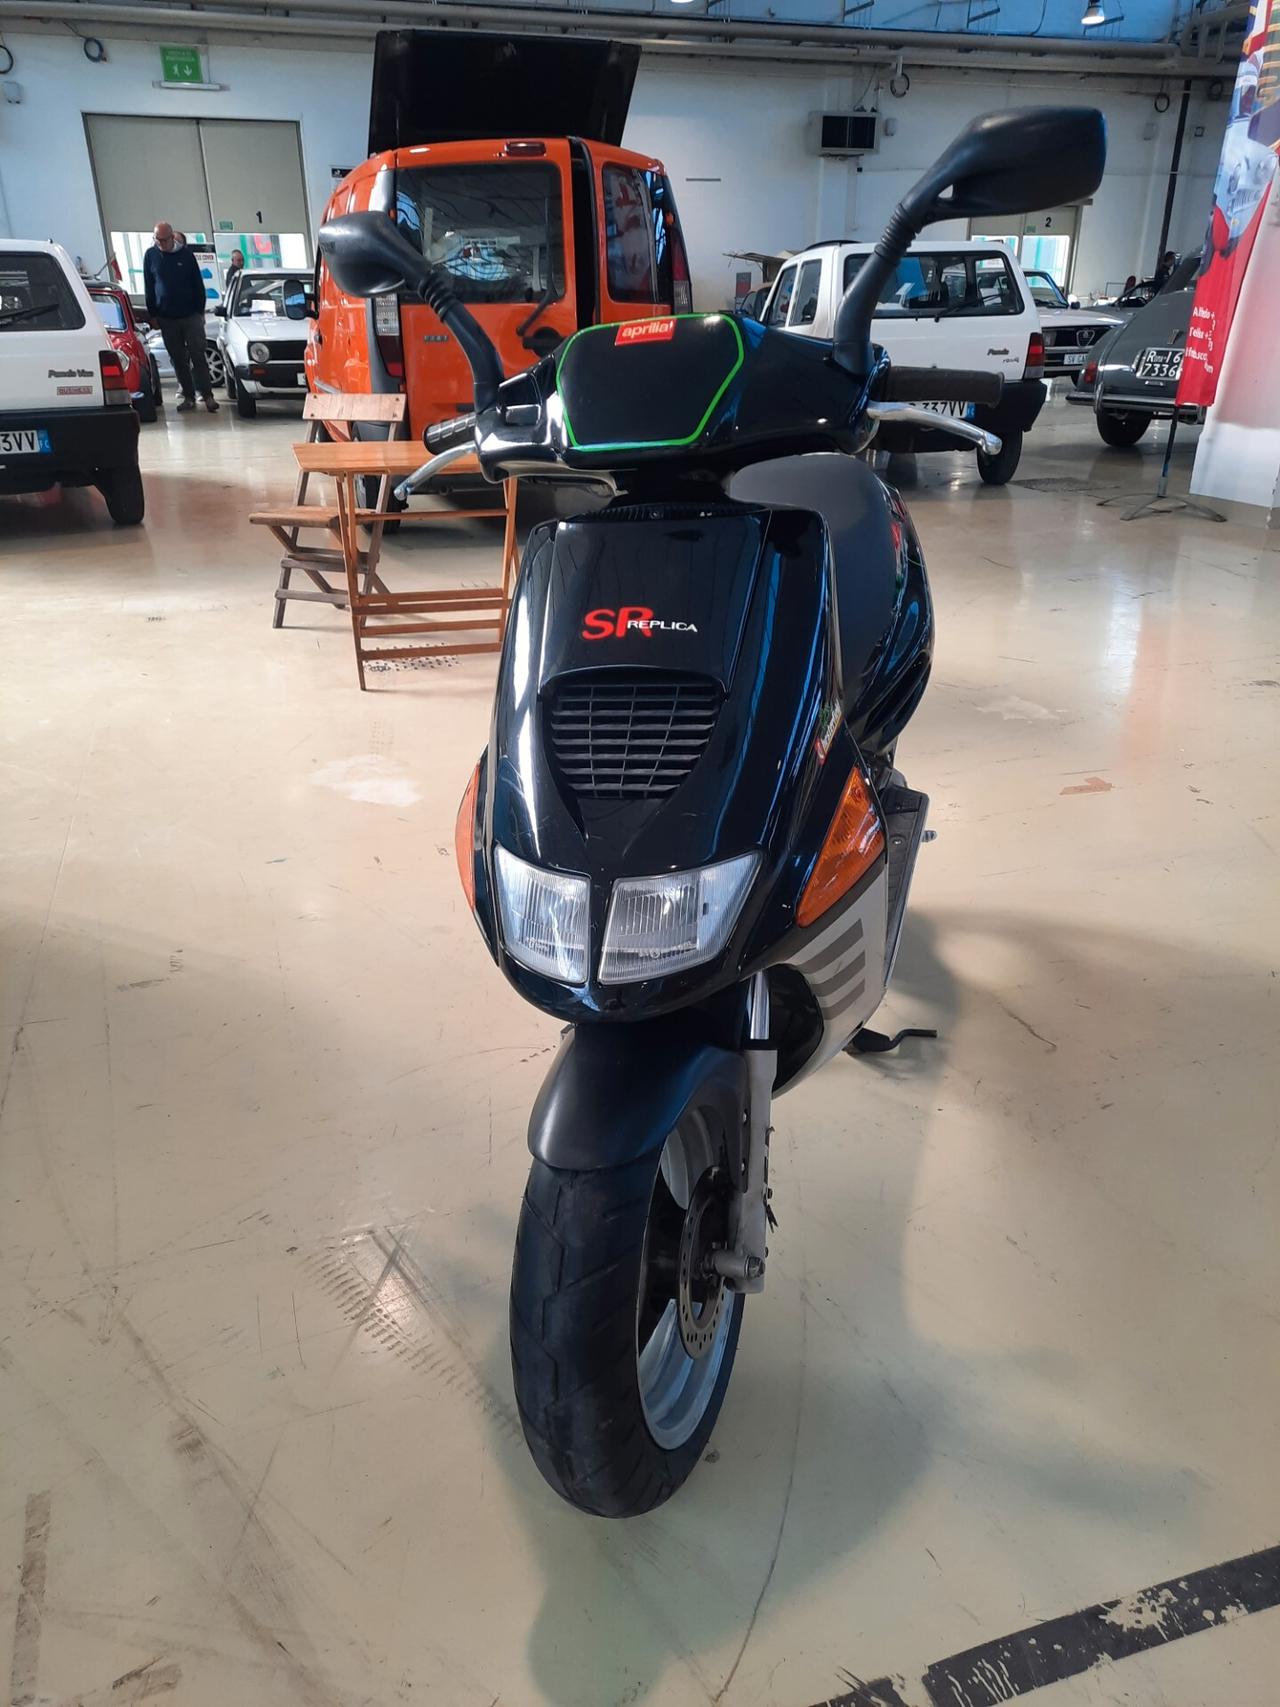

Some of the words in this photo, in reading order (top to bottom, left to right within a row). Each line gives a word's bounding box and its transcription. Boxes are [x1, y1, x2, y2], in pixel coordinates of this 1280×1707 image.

[256, 211, 262, 224] 1
[1045, 216, 1052, 228] 2
[621, 321, 669, 339] aprilia
[627, 620, 698, 633] REPLICA
